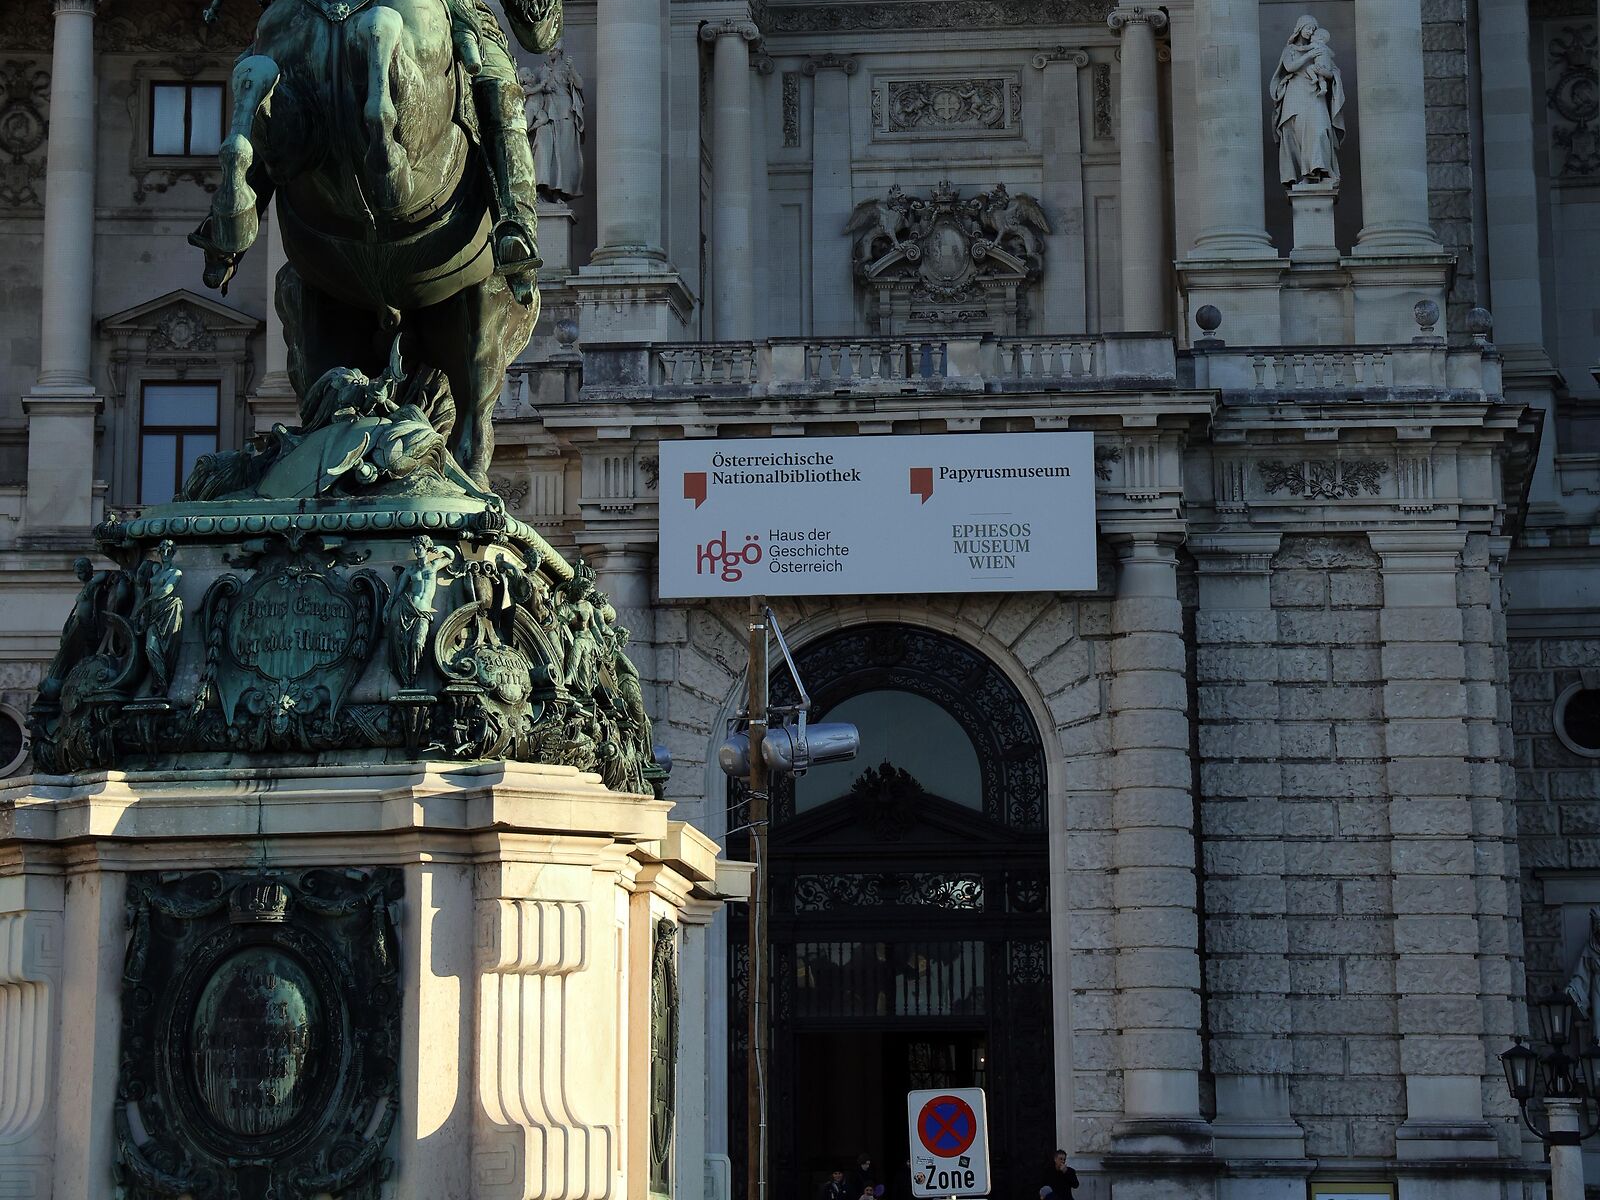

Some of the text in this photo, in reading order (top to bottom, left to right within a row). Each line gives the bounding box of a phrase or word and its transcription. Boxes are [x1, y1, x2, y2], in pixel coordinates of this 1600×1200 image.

[711, 451, 834, 468] Österreichische
[711, 468, 862, 485] Nationalbibliothek
[938, 466, 1071, 482] Papyrusmuseum
[769, 528, 832, 542] Haus der
[952, 523, 1032, 539] EPHESOS
[768, 544, 850, 558] Geschichte
[953, 538, 1031, 555] MUSEUM
[769, 558, 843, 574] Österreich
[968, 554, 1017, 570] WIEN
[926, 1165, 975, 1190] Zone
